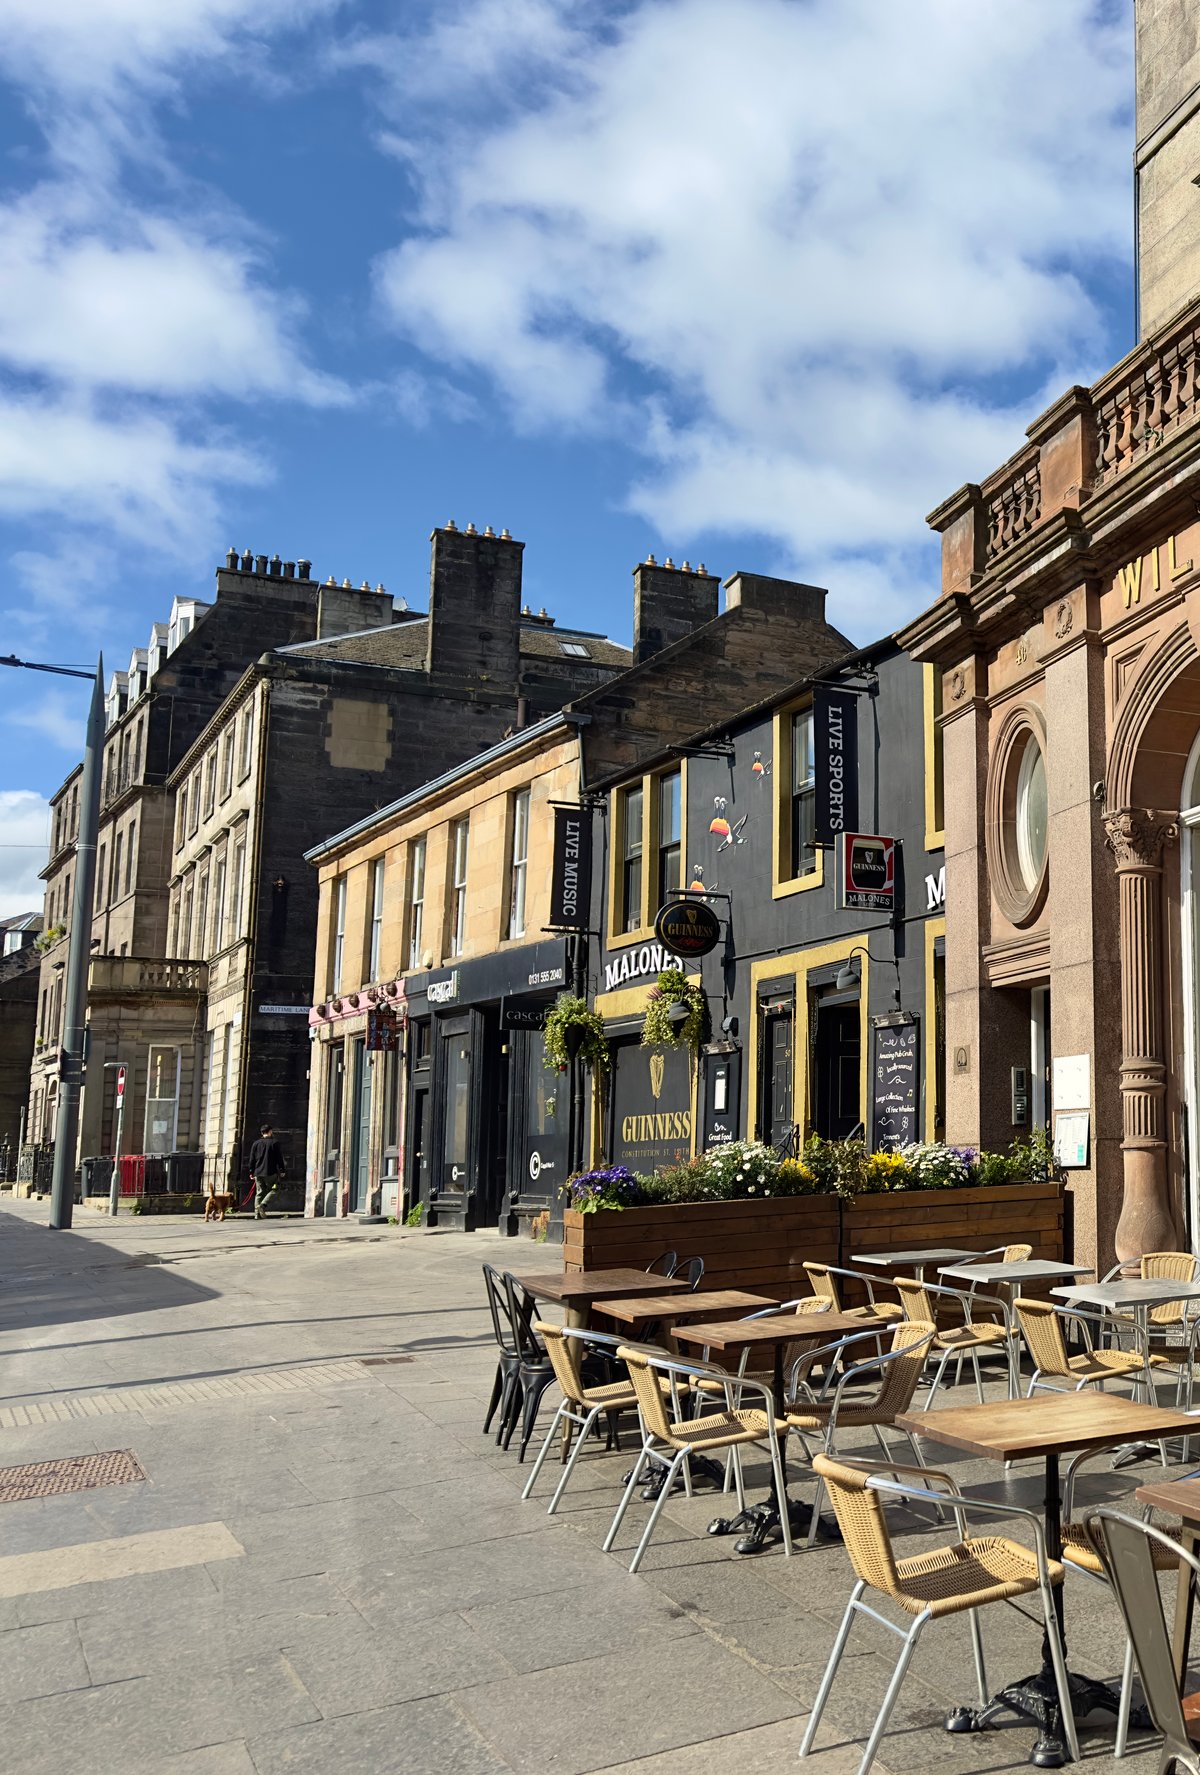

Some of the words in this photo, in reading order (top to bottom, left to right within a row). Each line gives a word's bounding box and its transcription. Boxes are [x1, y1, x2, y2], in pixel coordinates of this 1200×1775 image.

[828, 705, 844, 750] LIVE
[829, 754, 845, 830] SPORTS
[565, 820, 580, 858] LIVE
[853, 862, 886, 872] GUINNESS
[562, 861, 579, 916] MUSIC
[848, 893, 891, 906] MALONES
[668, 922, 714, 938] GUINNESS
[604, 945, 684, 991] MALONES
[885, 1091, 904, 1101] Collection
[622, 1111, 691, 1142] GUINNESS
[721, 1131, 733, 1141] Food
[621, 1149, 660, 1158] CONSTITUTION
